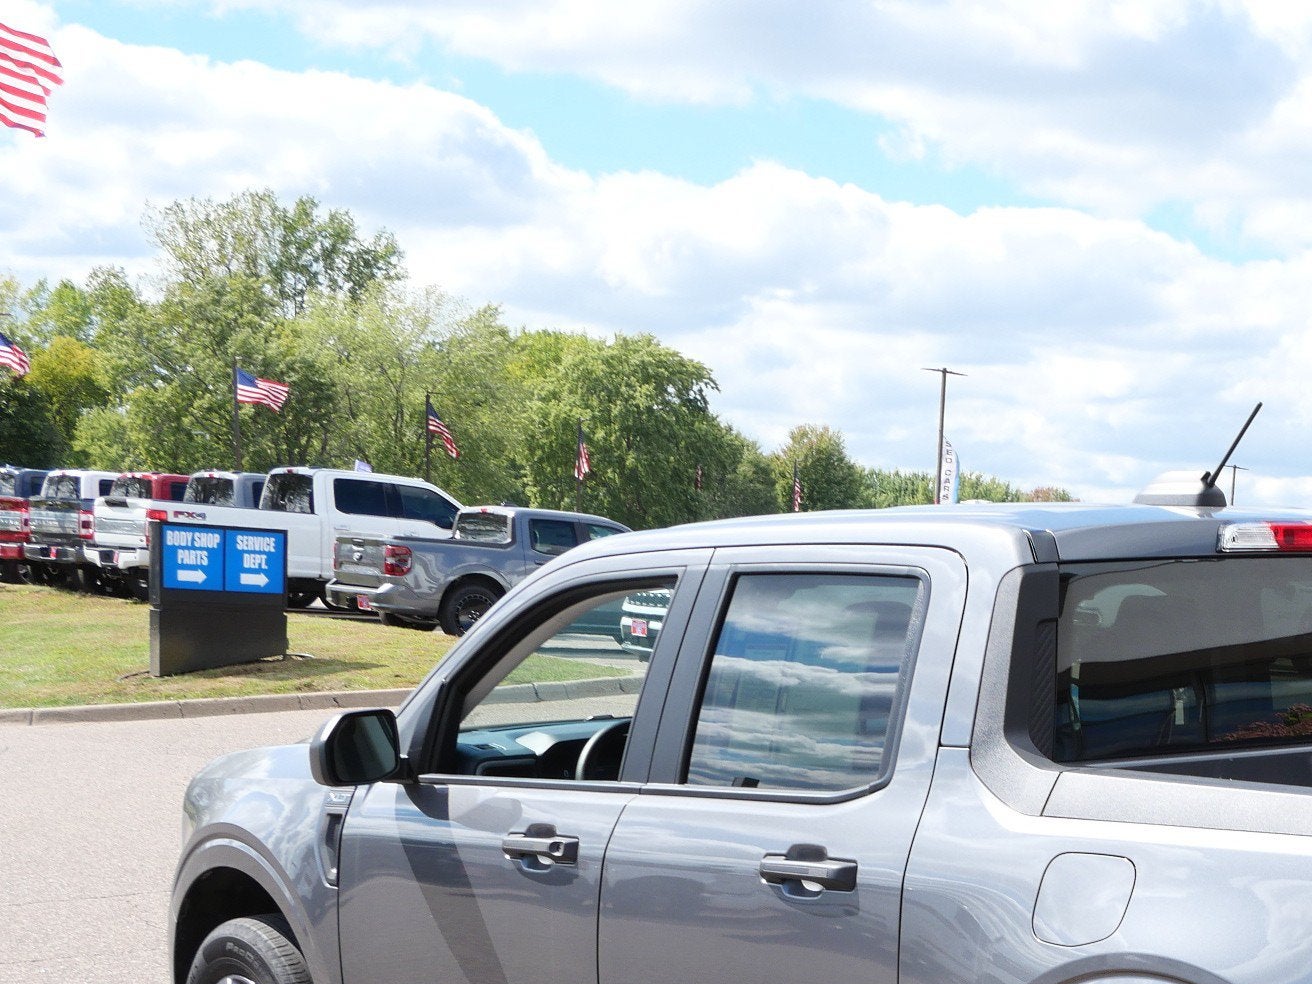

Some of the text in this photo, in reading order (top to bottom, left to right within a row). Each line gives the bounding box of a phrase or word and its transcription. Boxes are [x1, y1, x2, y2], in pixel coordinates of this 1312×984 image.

[166, 530, 221, 549] BODY SHOP
[236, 534, 276, 553] SERVICE
[177, 548, 209, 566] PARTS
[243, 553, 268, 570] DEPT.
